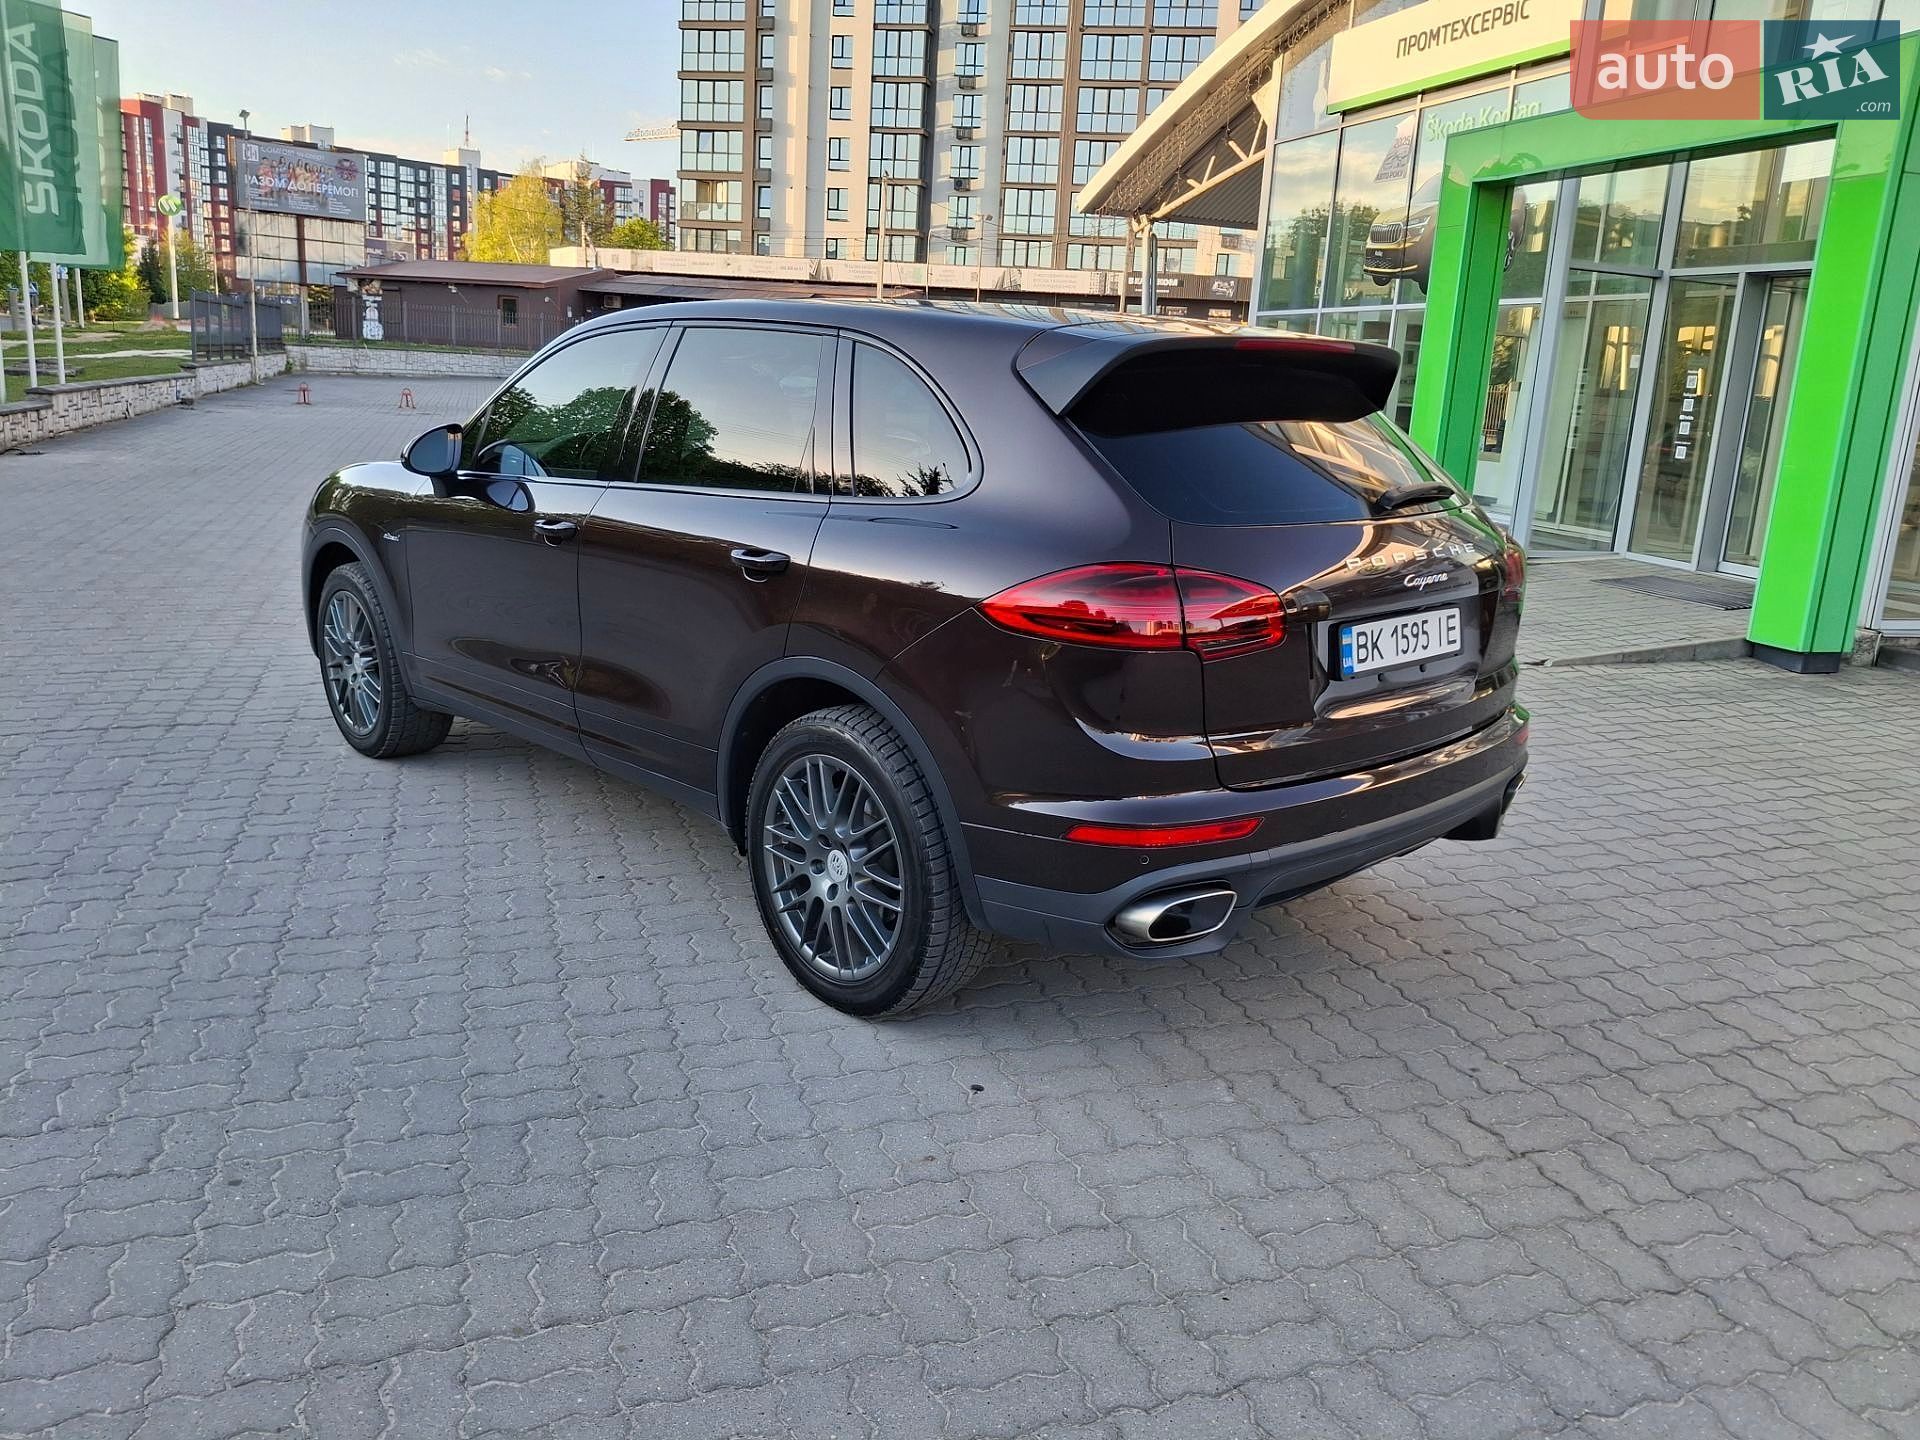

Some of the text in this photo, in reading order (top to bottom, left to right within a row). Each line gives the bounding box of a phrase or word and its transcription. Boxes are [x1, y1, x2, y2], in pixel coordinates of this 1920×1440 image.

[1396, 0, 1530, 59] ПРОМТЕХСЕРВІС
[1345, 542, 1476, 572] PORSCHE
[1403, 572, 1449, 591] Cayenne
[1356, 614, 1457, 664] BK 1595 IE
